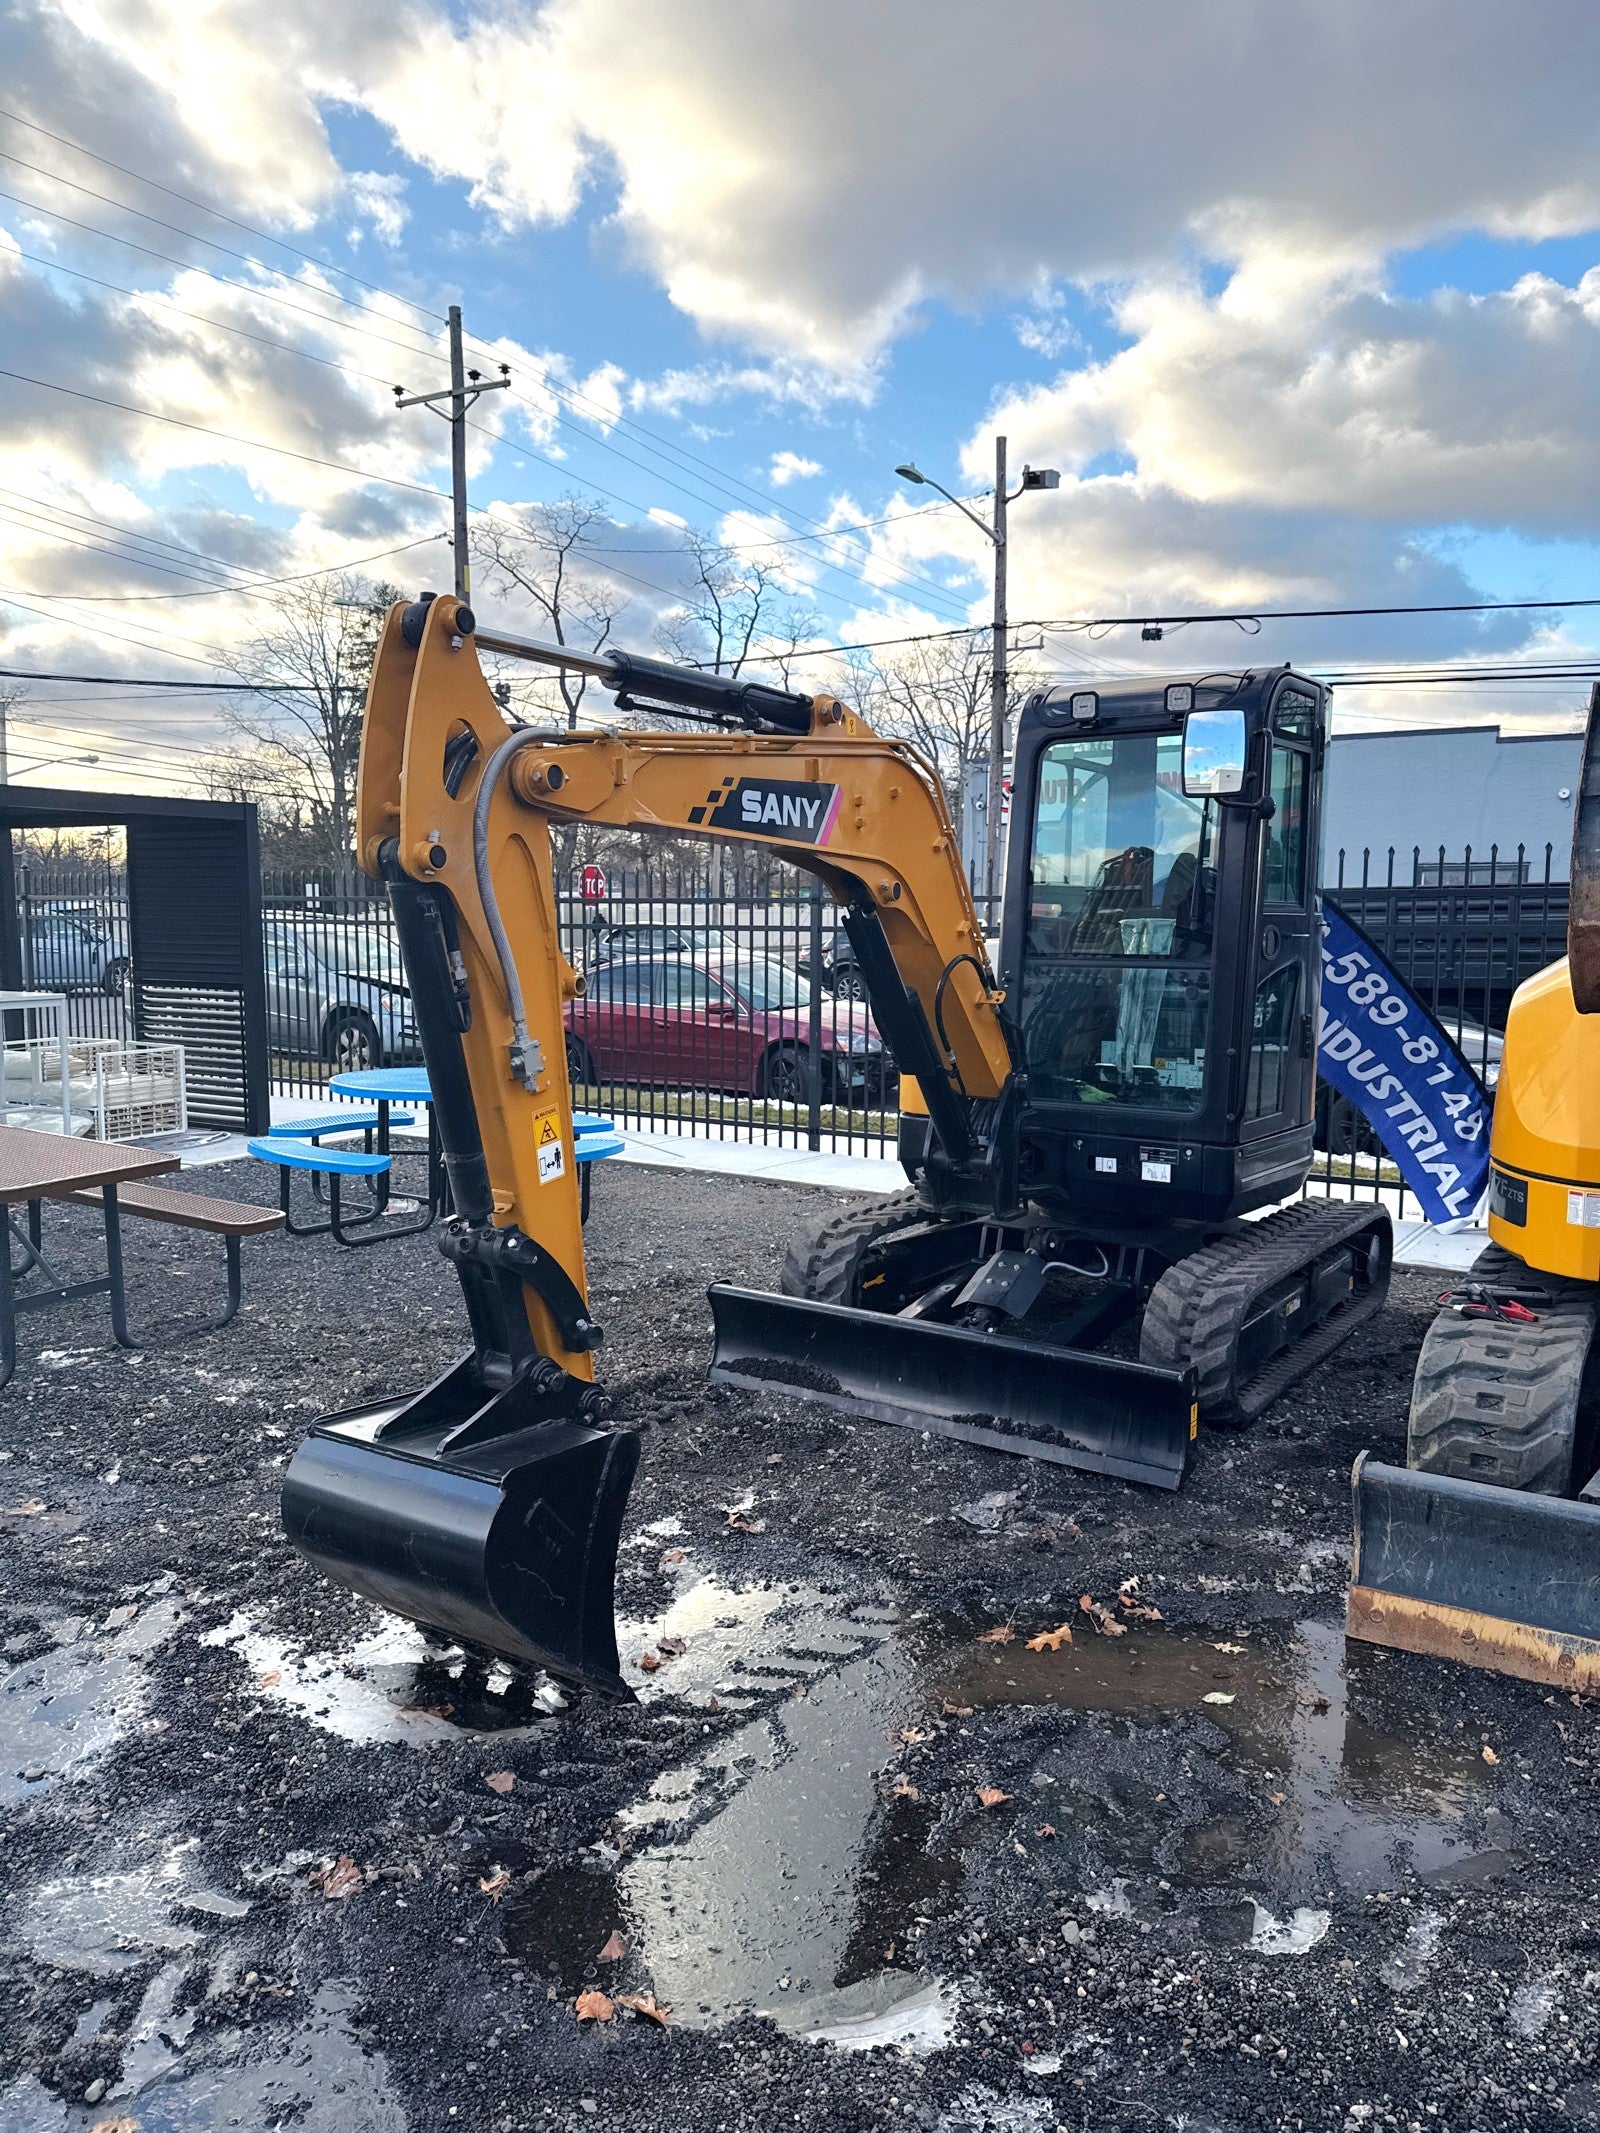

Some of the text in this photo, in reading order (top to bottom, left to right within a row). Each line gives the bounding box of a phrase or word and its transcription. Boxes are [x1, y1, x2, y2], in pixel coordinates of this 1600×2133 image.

[742, 790, 821, 828] SANY
[580, 878, 604, 894] TOP
[1321, 920, 1484, 1142] -589-8148
[1317, 1005, 1471, 1216] NDUSTRIAL
